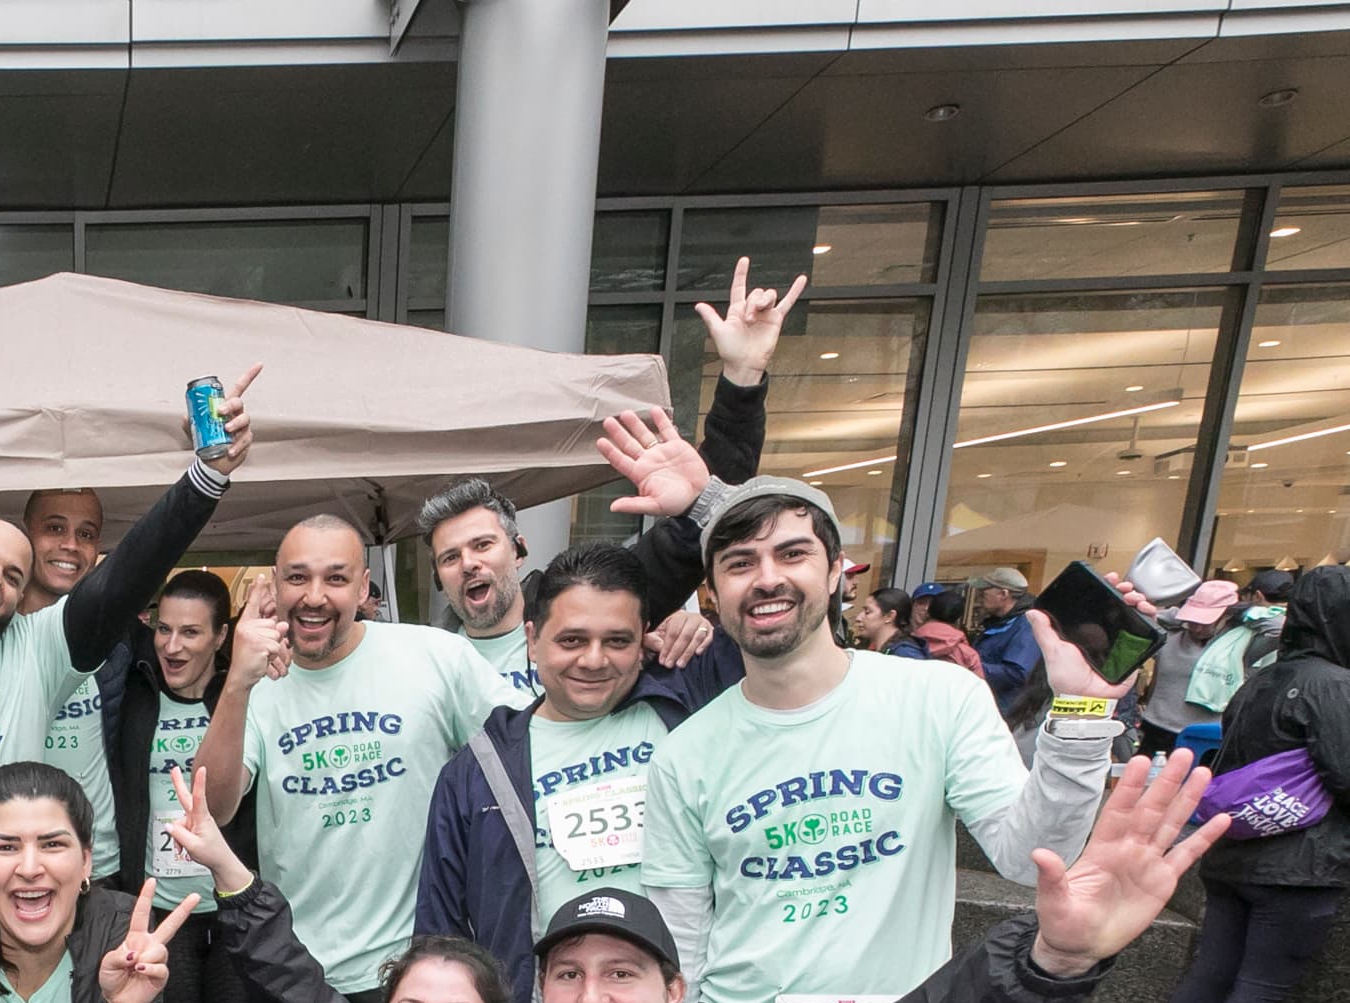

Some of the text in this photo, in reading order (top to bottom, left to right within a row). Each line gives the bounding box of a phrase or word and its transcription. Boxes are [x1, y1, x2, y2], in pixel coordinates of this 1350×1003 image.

[278, 712, 402, 755] SPRING
[353, 741, 381, 753] ROAD
[354, 751, 382, 762] RACE
[302, 750, 329, 771] 5K
[282, 757, 406, 795] CLASSIC
[726, 769, 904, 834] SPRING
[1271, 786, 1310, 818] PEACE
[322, 808, 371, 828] 2023
[830, 808, 872, 823] ROAD
[831, 821, 873, 836] RACE
[764, 821, 798, 849] 5K
[740, 831, 905, 880] CLASSIC
[782, 896, 849, 922] 2023
